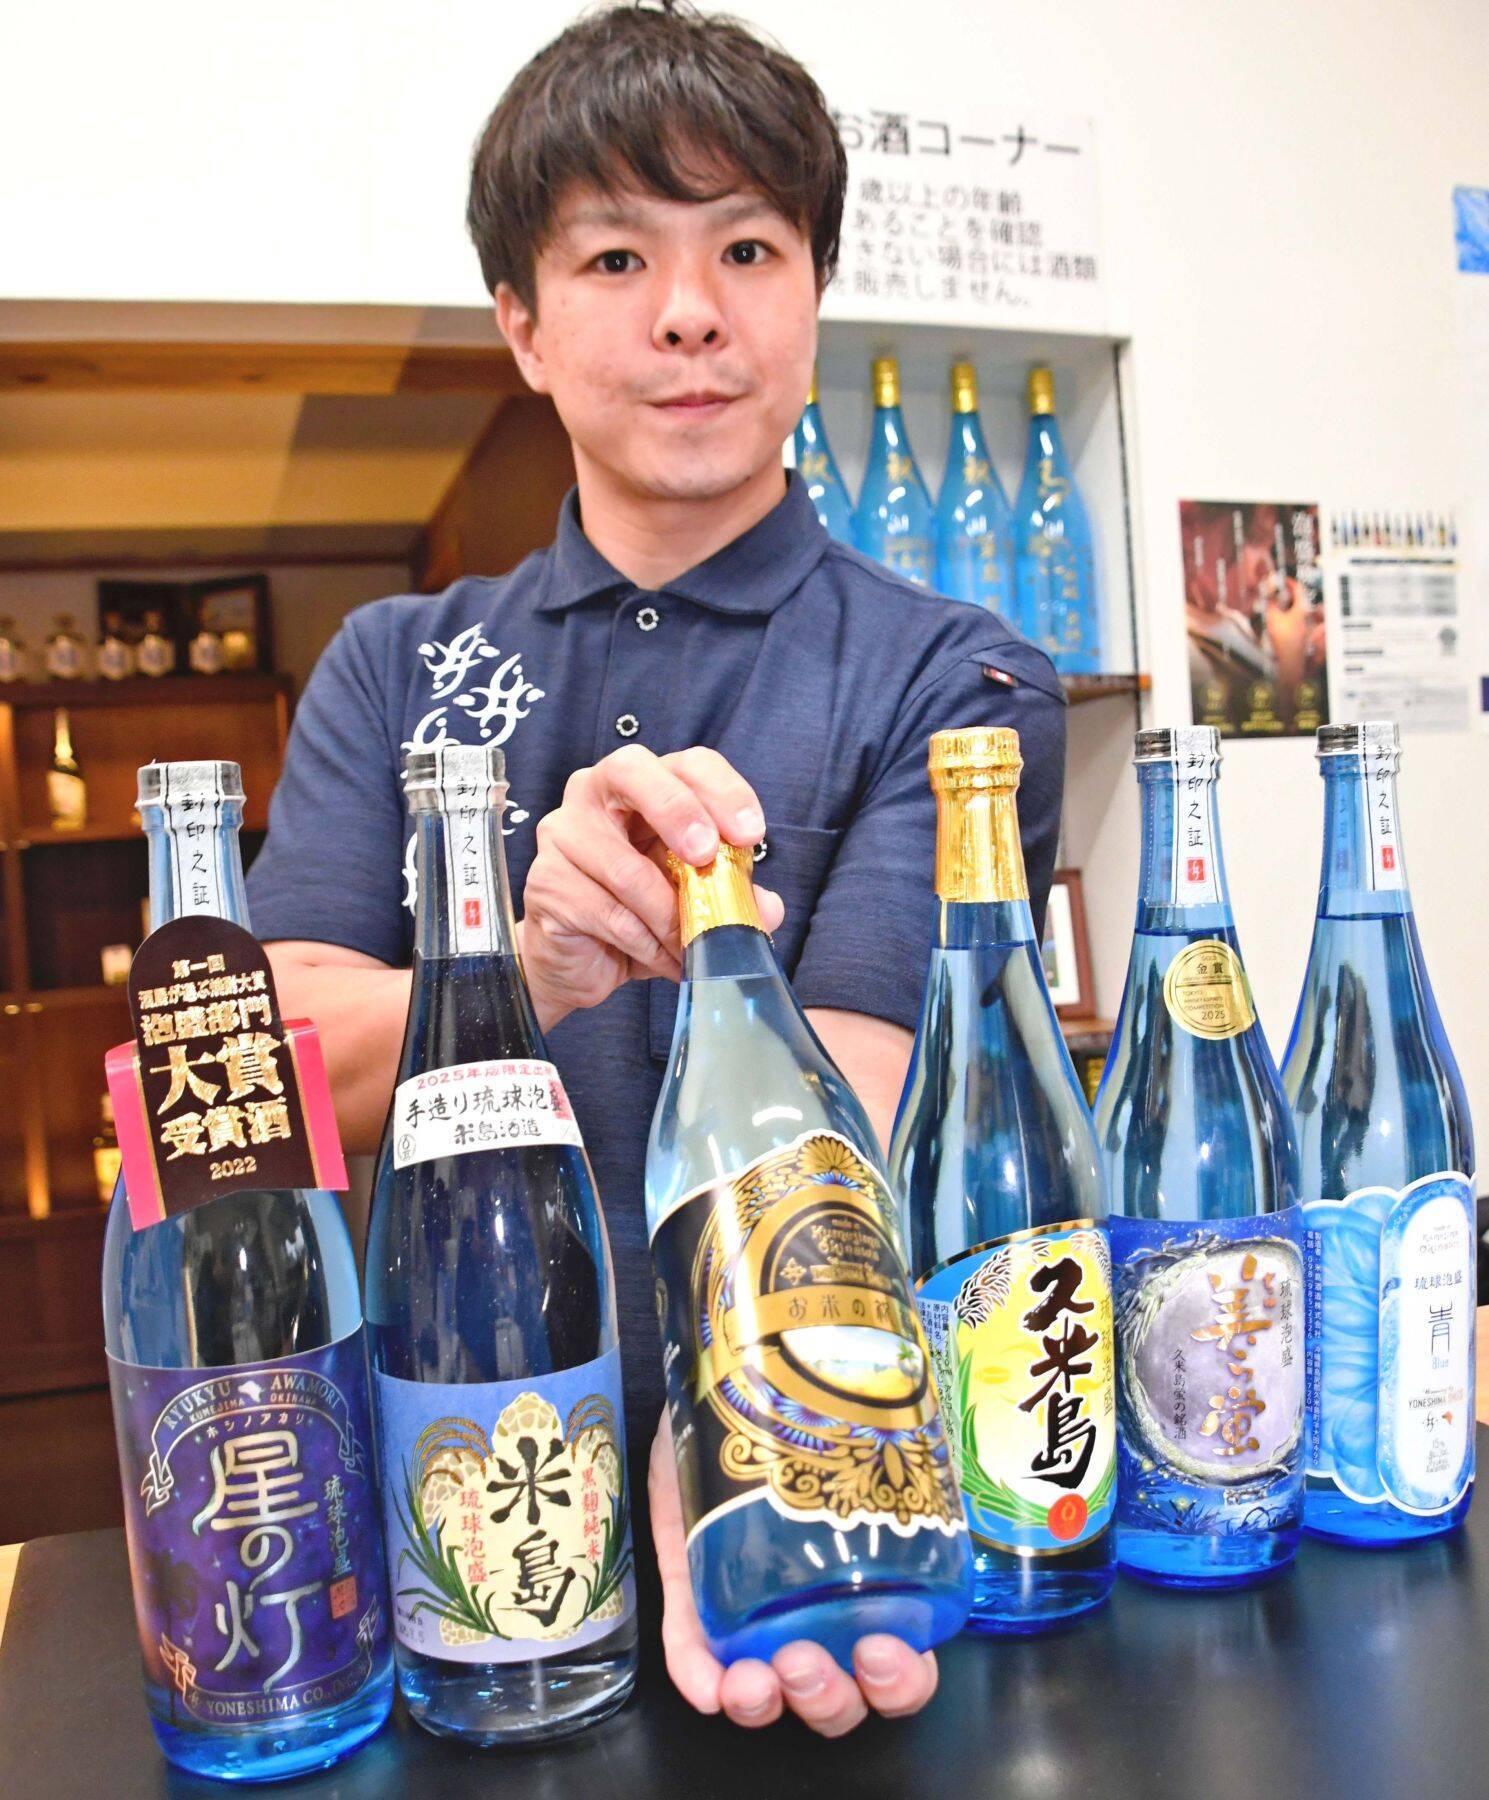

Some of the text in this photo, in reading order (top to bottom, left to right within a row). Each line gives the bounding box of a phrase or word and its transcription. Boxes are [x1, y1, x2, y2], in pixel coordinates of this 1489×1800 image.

[172, 954, 226, 979] 第一回
[140, 993, 273, 1047] 泡盛部門
[150, 1032, 285, 1116] 大賞
[160, 1096, 293, 1162] 受賞酒
[453, 1117, 542, 1146] 米島酒造
[210, 1155, 257, 1181] 2022
[1018, 1257, 1100, 1490] 久米島
[163, 1374, 343, 1431] RYUKYU AWAMORI
[188, 1397, 246, 1424] KUMEJIMA
[206, 1412, 306, 1439] ホシノアカリ
[459, 1489, 488, 1583] 琉球泡盛
[487, 1436, 576, 1628] 米島
[192, 1431, 321, 1696] 星の灯
[206, 1693, 299, 1717] YONESHIMA
